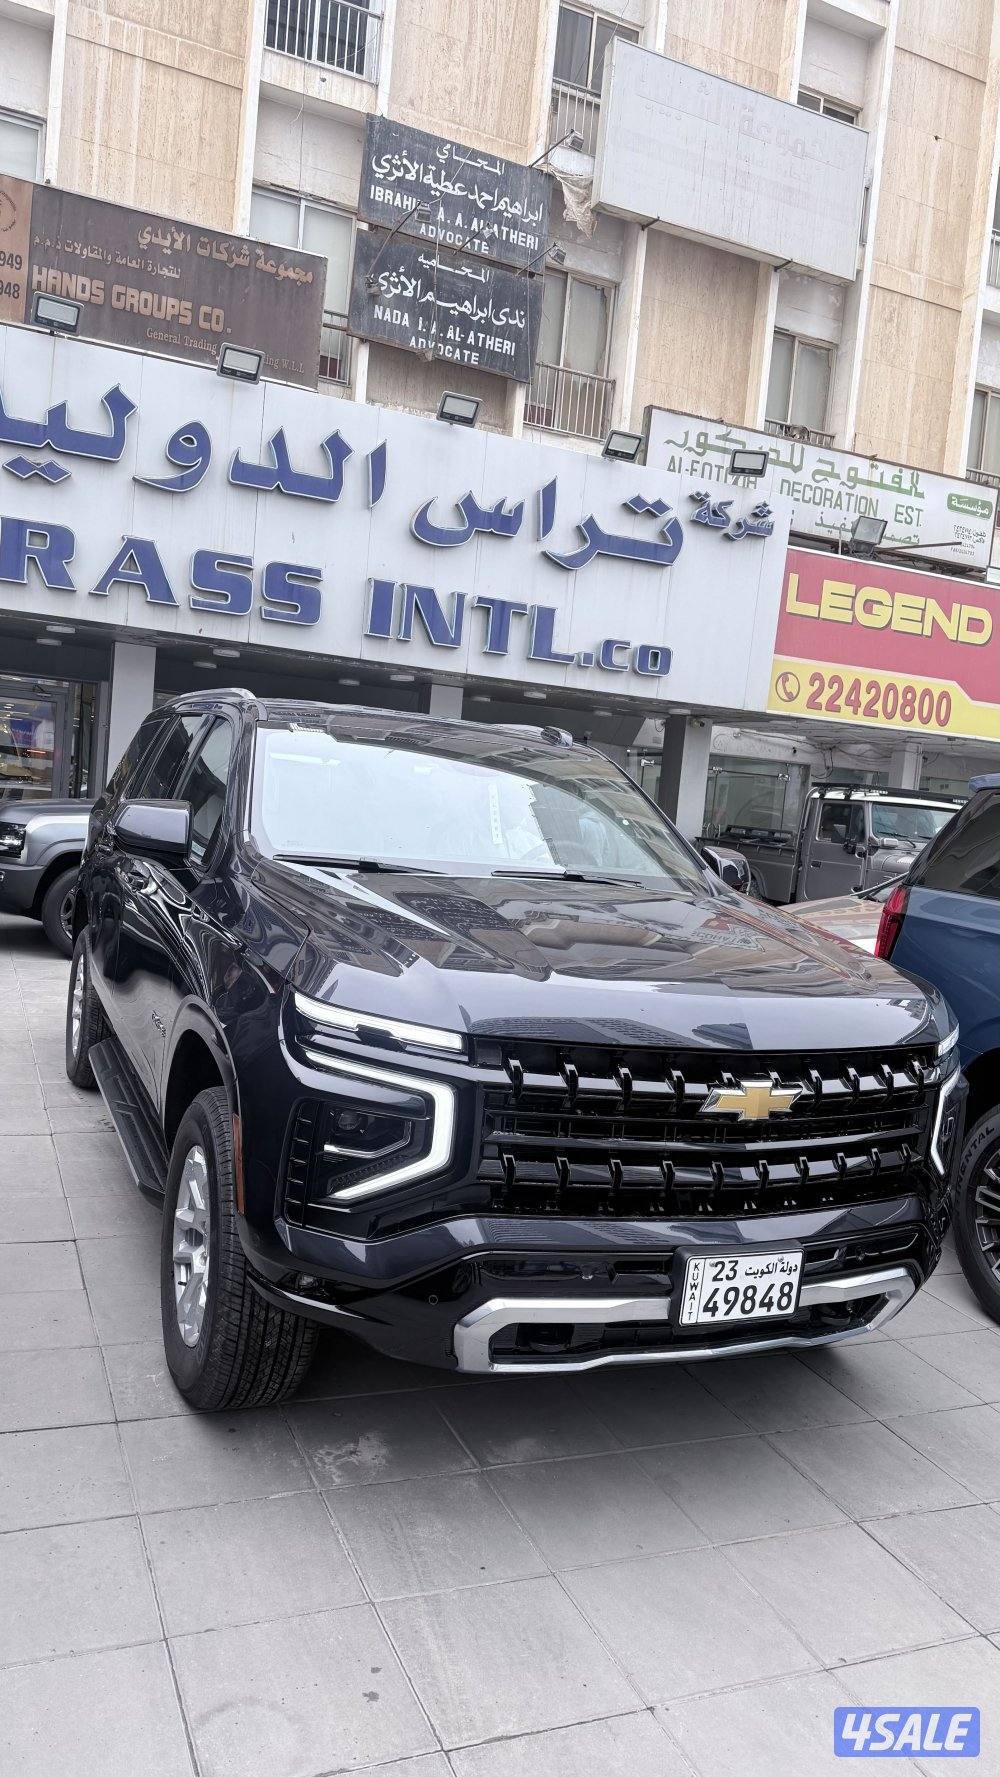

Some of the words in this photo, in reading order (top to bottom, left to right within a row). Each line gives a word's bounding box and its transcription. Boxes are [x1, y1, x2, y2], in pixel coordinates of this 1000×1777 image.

[370, 184, 421, 211] IBRAHI
[196, 235, 251, 269] شركات
[419, 223, 490, 254] ADVOCATE
[255, 249, 314, 286] مجموعة
[32, 265, 106, 306] HANDS
[111, 284, 193, 327] GROUPS
[198, 305, 233, 334] CO.
[146, 327, 181, 346] General
[183, 334, 218, 356] Trading
[373, 305, 410, 328] NADA
[446, 325, 516, 356] AL-ATHERI
[0, 383, 389, 511] الدولي
[409, 475, 684, 573] تراس
[688, 490, 775, 543] شركة
[894, 503, 924, 527] EST.
[785, 572, 994, 647] LEGEND
[805, 671, 952, 727] 22420800
[711, 1259, 739, 1282] 23
[744, 1262, 778, 1279] الكويت
[780, 1261, 798, 1276] دولة
[688, 1262, 700, 1320] KUWAIT
[702, 1281, 794, 1317] 49848
